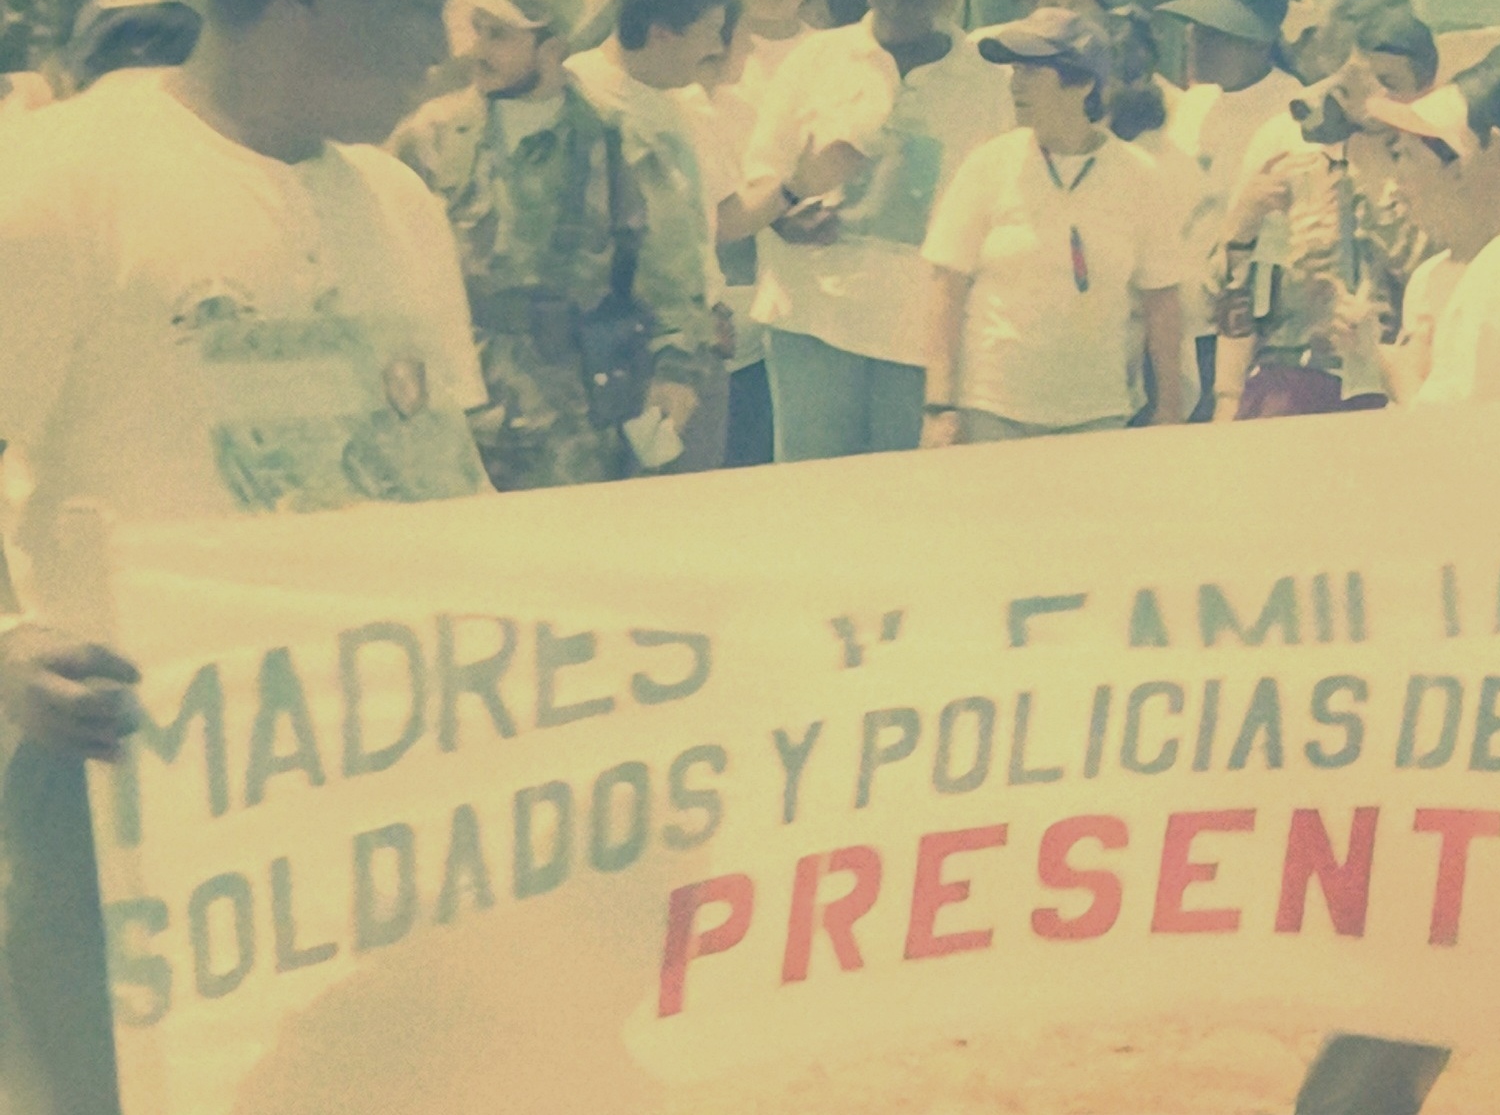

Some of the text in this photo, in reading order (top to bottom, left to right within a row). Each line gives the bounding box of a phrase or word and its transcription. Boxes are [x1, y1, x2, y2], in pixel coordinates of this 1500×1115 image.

[106, 743, 728, 1028] SOLDADOS
[772, 720, 823, 825] Y
[853, 674, 1370, 810] POLICIAS
[110, 612, 714, 849] MADRES
